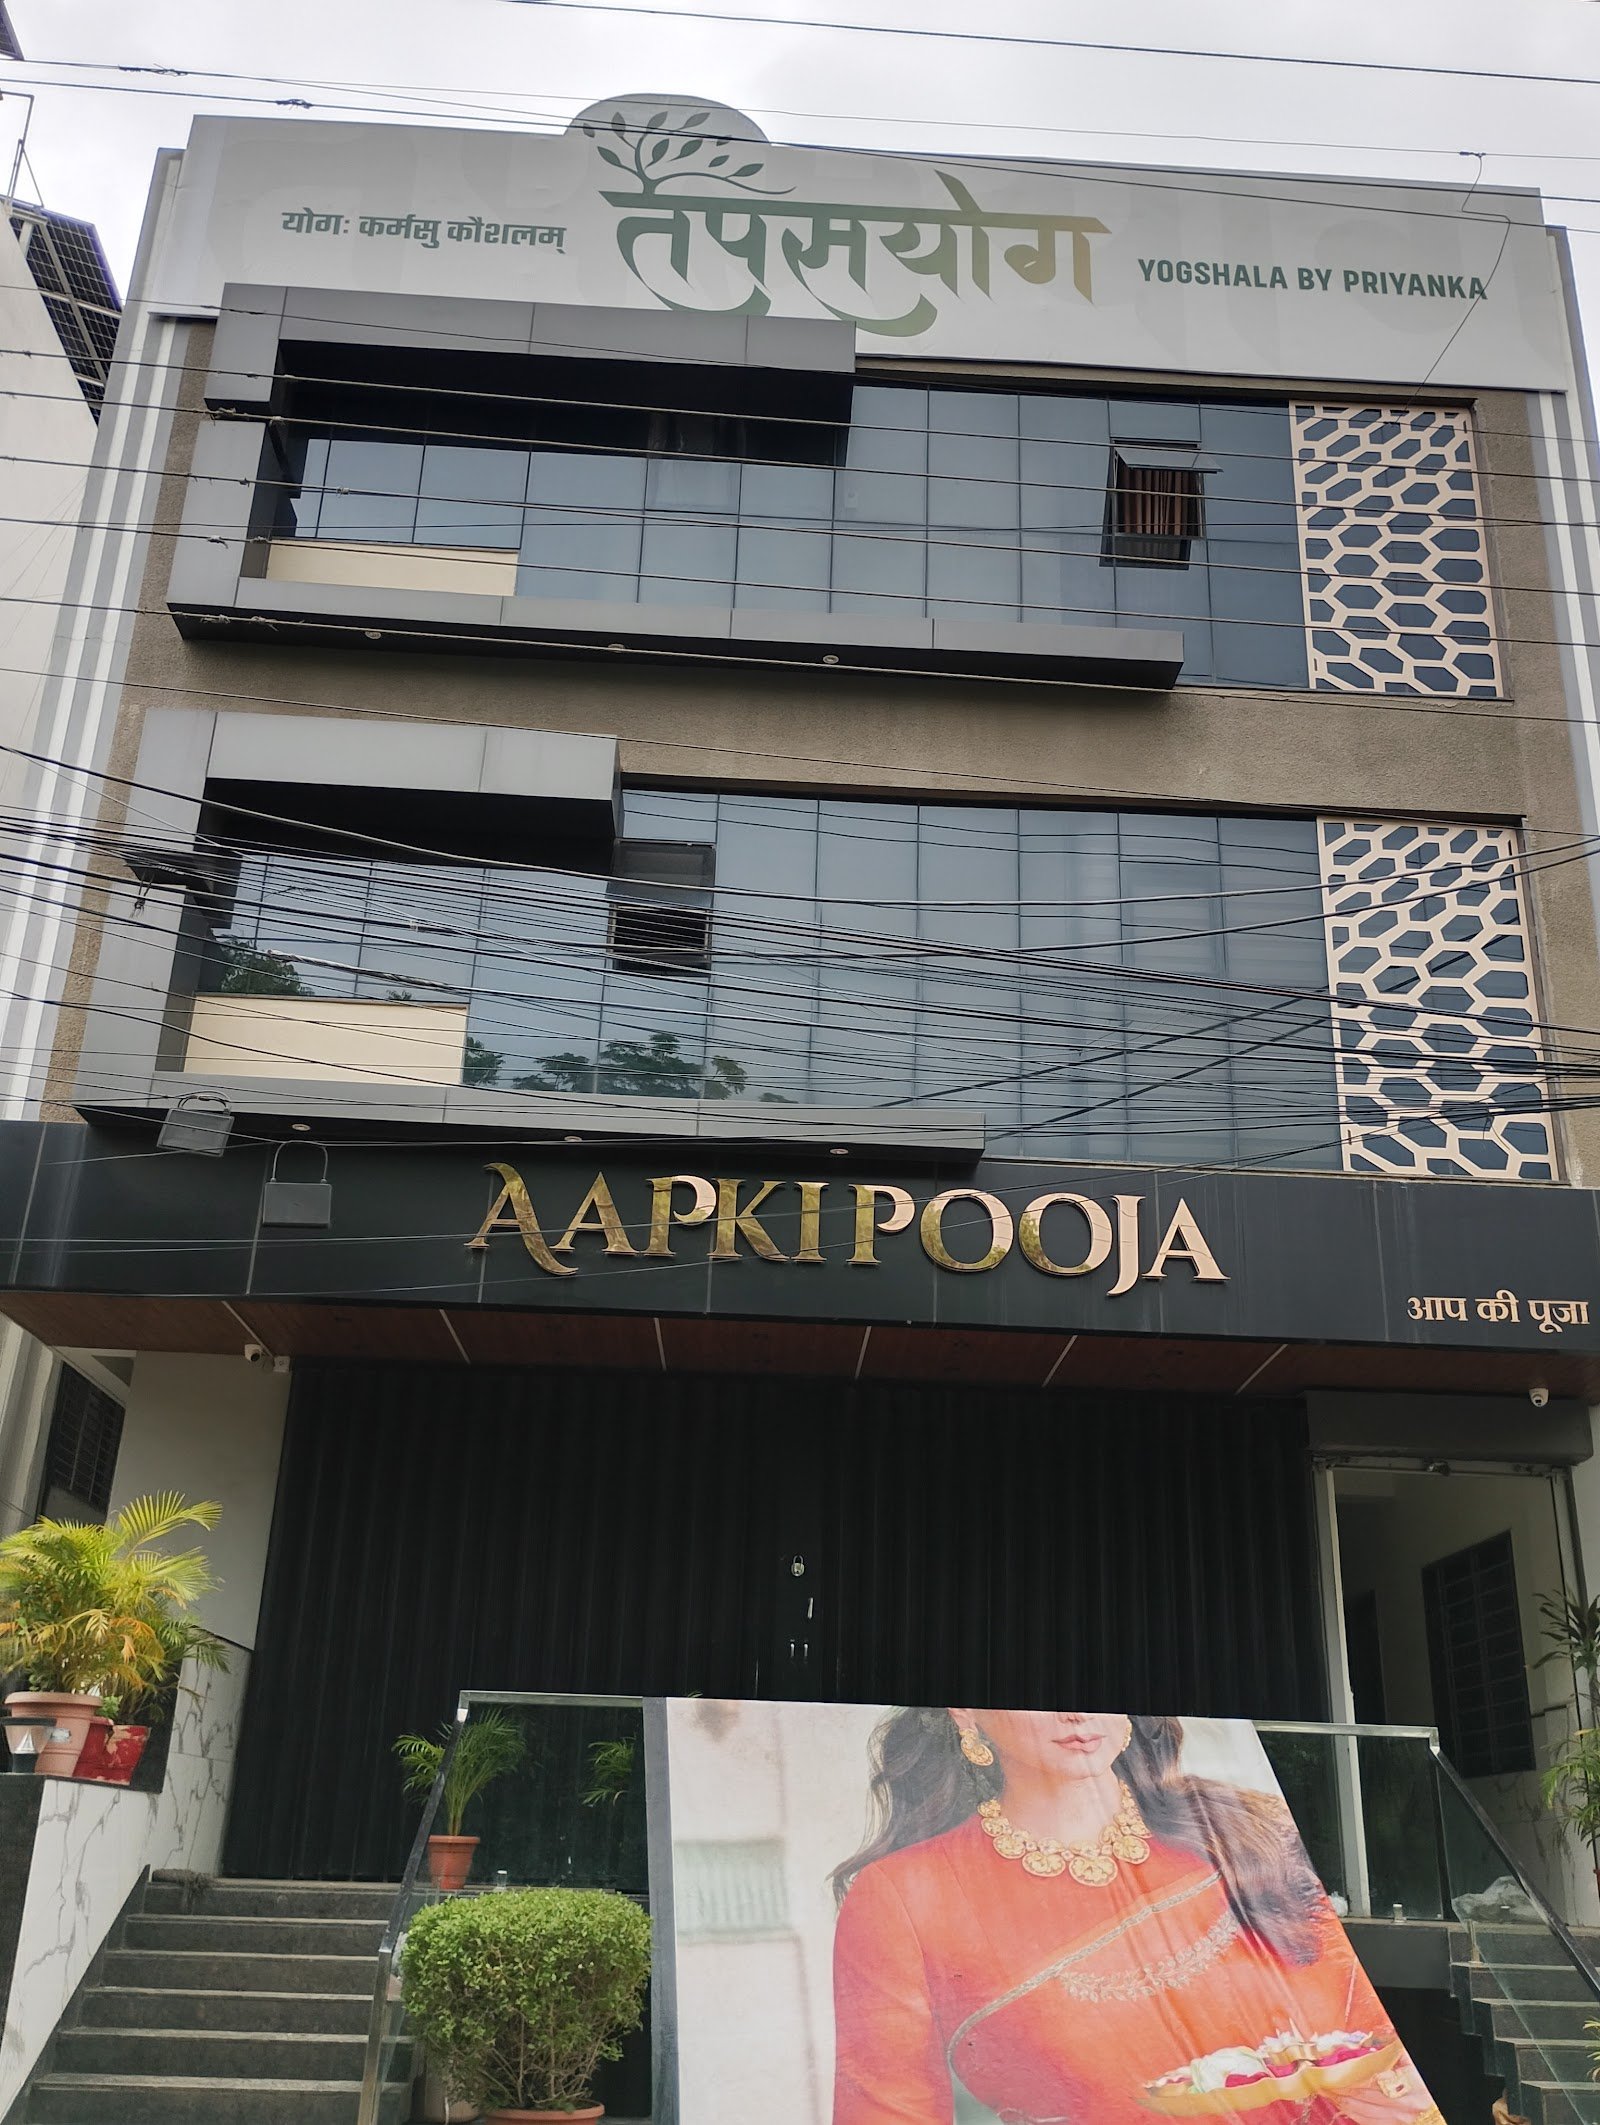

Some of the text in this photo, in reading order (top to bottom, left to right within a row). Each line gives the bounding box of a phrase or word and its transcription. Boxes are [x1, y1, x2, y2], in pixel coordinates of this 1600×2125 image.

[358, 214, 442, 249] कर्मसु
[447, 215, 568, 255] कौशलम्
[1138, 258, 1489, 301] YOGSHALA BY PRIYANKA
[463, 1162, 1231, 1298] AAPKI POOJA
[1407, 1289, 1591, 1334] आप की पूजा
